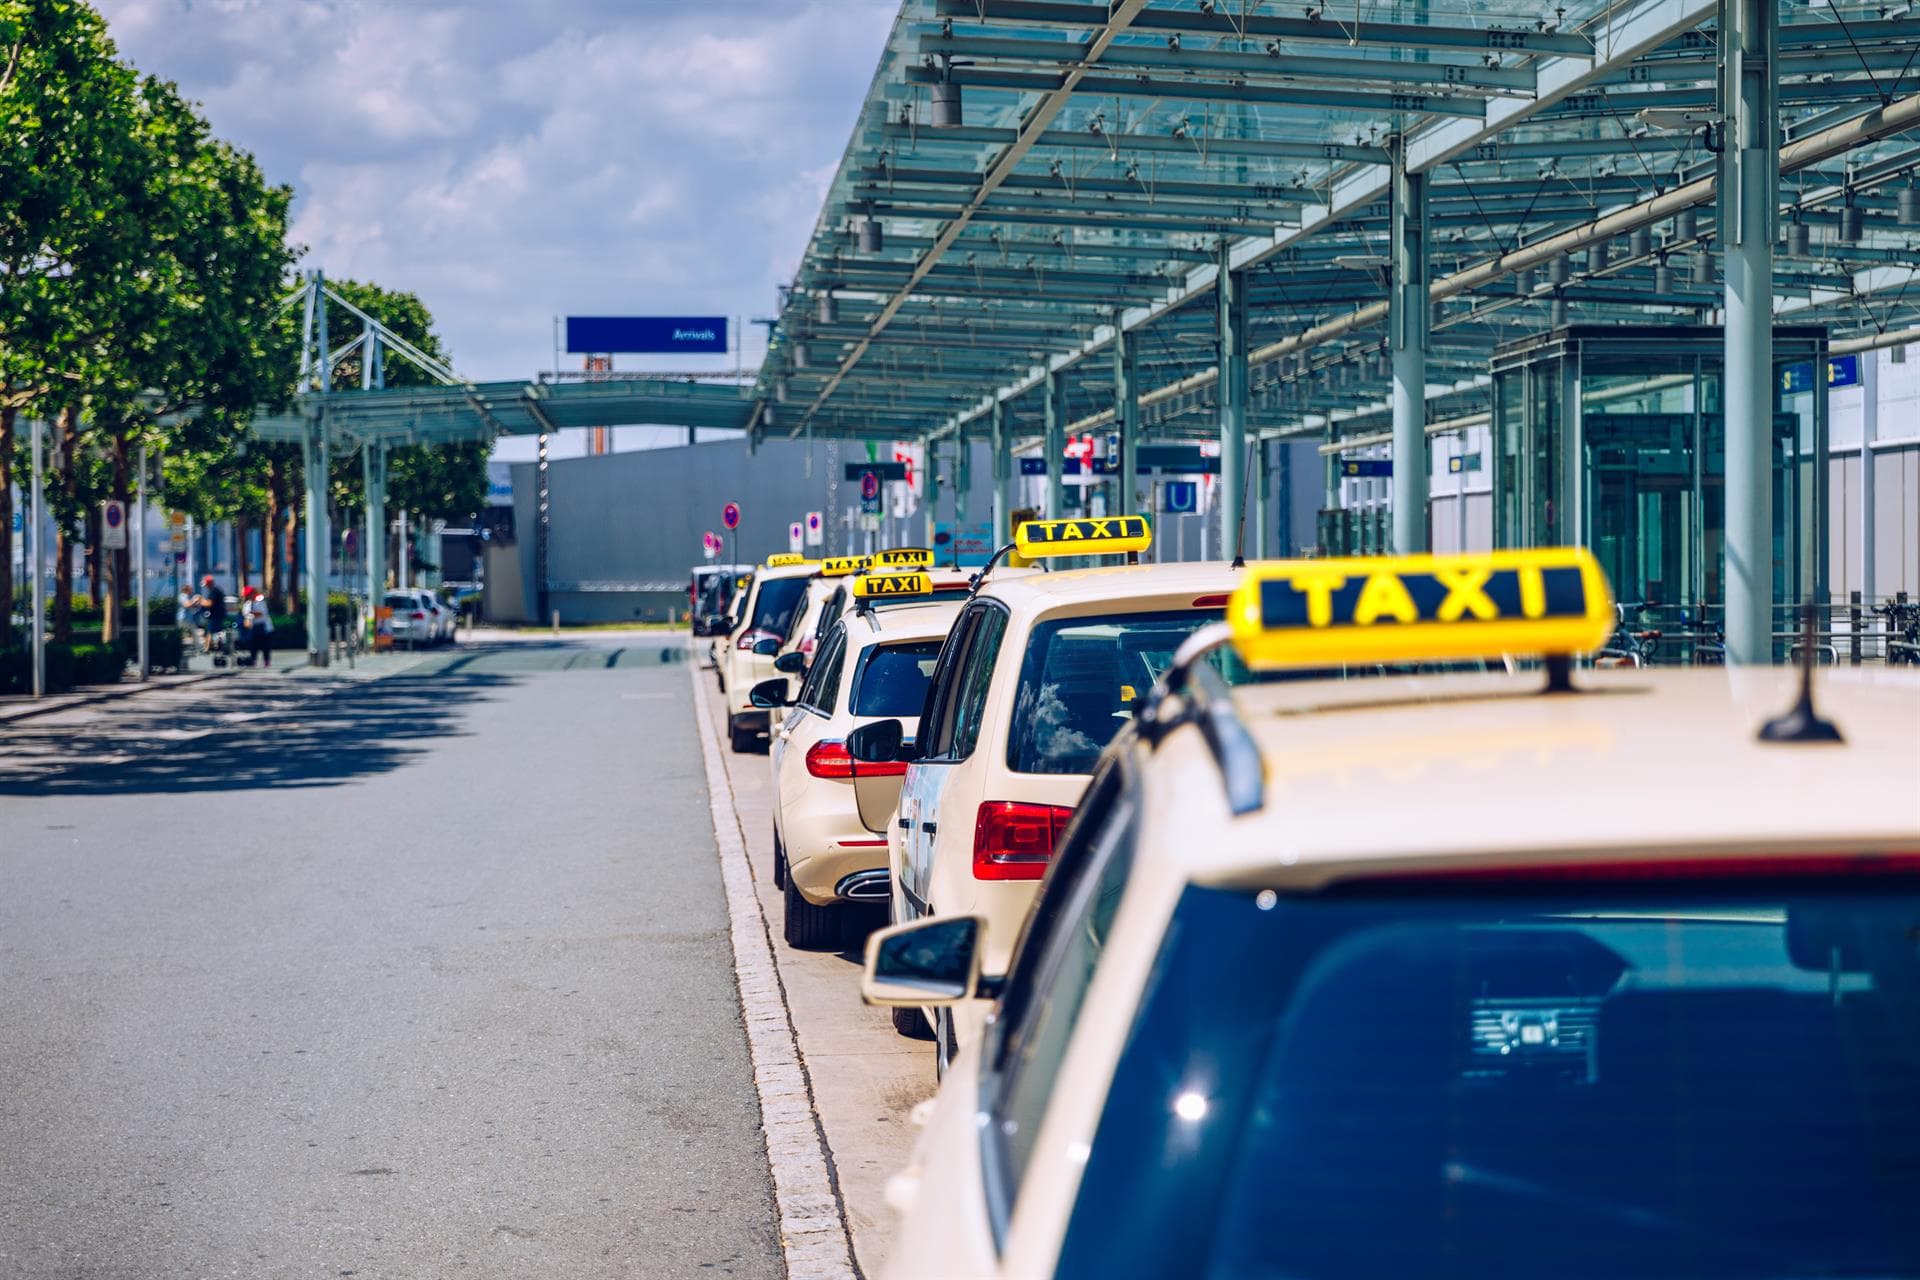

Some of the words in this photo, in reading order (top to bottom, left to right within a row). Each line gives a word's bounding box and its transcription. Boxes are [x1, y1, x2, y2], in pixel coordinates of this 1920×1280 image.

[1170, 484, 1192, 510] U
[1039, 520, 1129, 541] TAXI
[887, 552, 923, 563] TAXI
[868, 577, 919, 593] TAXI
[1290, 565, 1547, 628] TAXI
